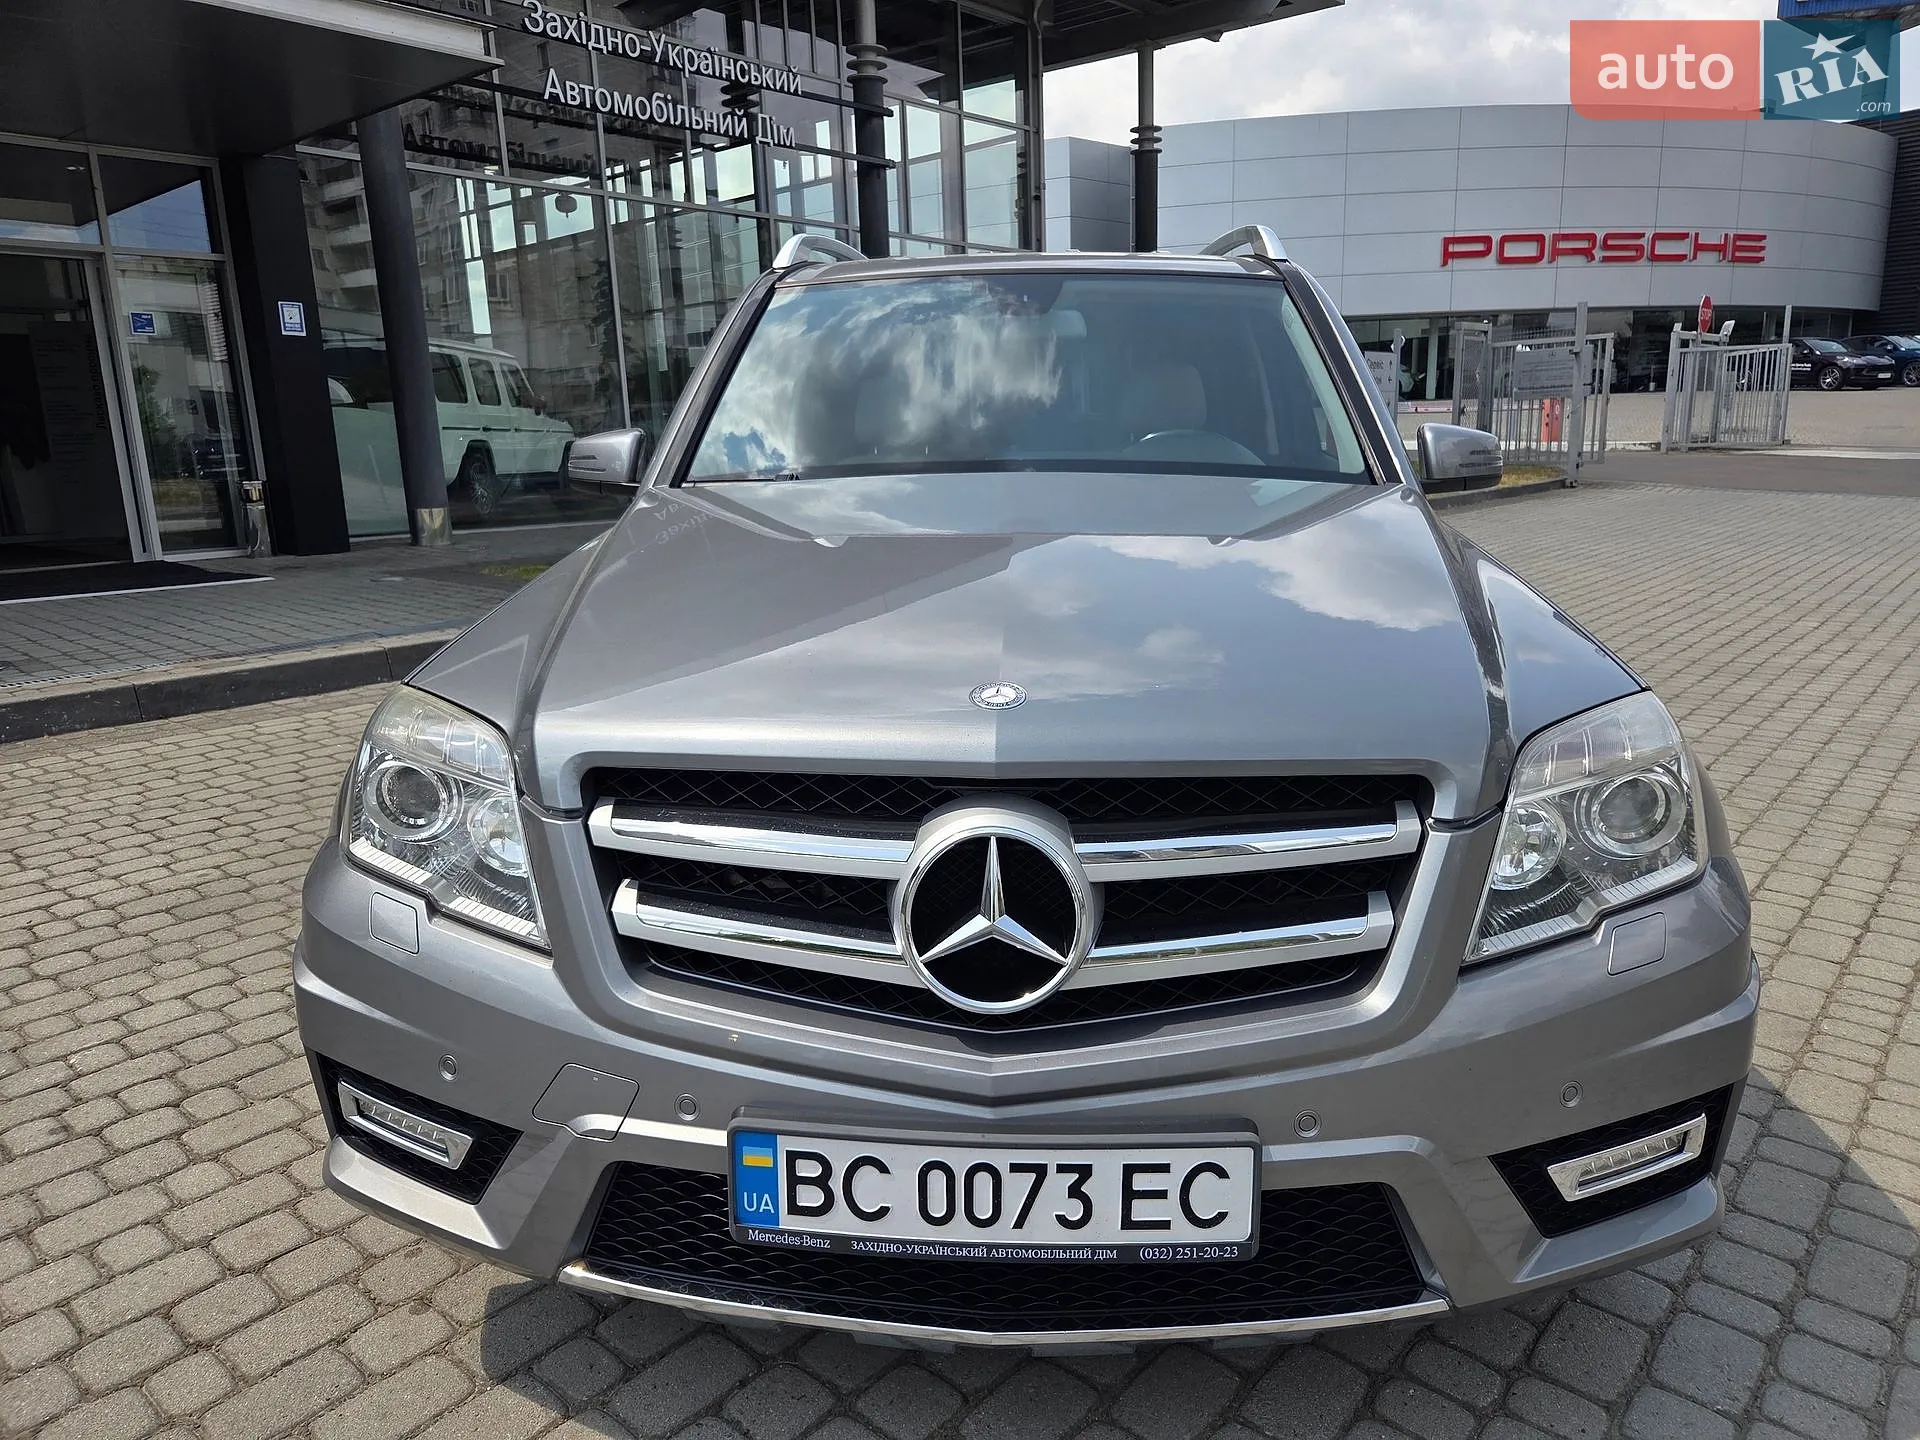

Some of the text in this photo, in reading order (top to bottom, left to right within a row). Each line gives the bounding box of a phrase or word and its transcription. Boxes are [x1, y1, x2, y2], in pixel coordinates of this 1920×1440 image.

[522, 0, 802, 95] Західно-Український
[543, 67, 748, 139] Автомобільний
[755, 112, 797, 148] Дім
[1441, 232, 1768, 267] PORSCHE
[743, 1192, 775, 1214] UA
[786, 1149, 1230, 1231] BC 0073 EC
[747, 1229, 831, 1249] Mercedes-Benz
[850, 1240, 1118, 1261] ЗАХІДНО-УКРАЇНСЬКИЙ АВТОМОБІЛЬНИЙ ДІМ
[1139, 1246, 1239, 1261] (032) 251-20-23
